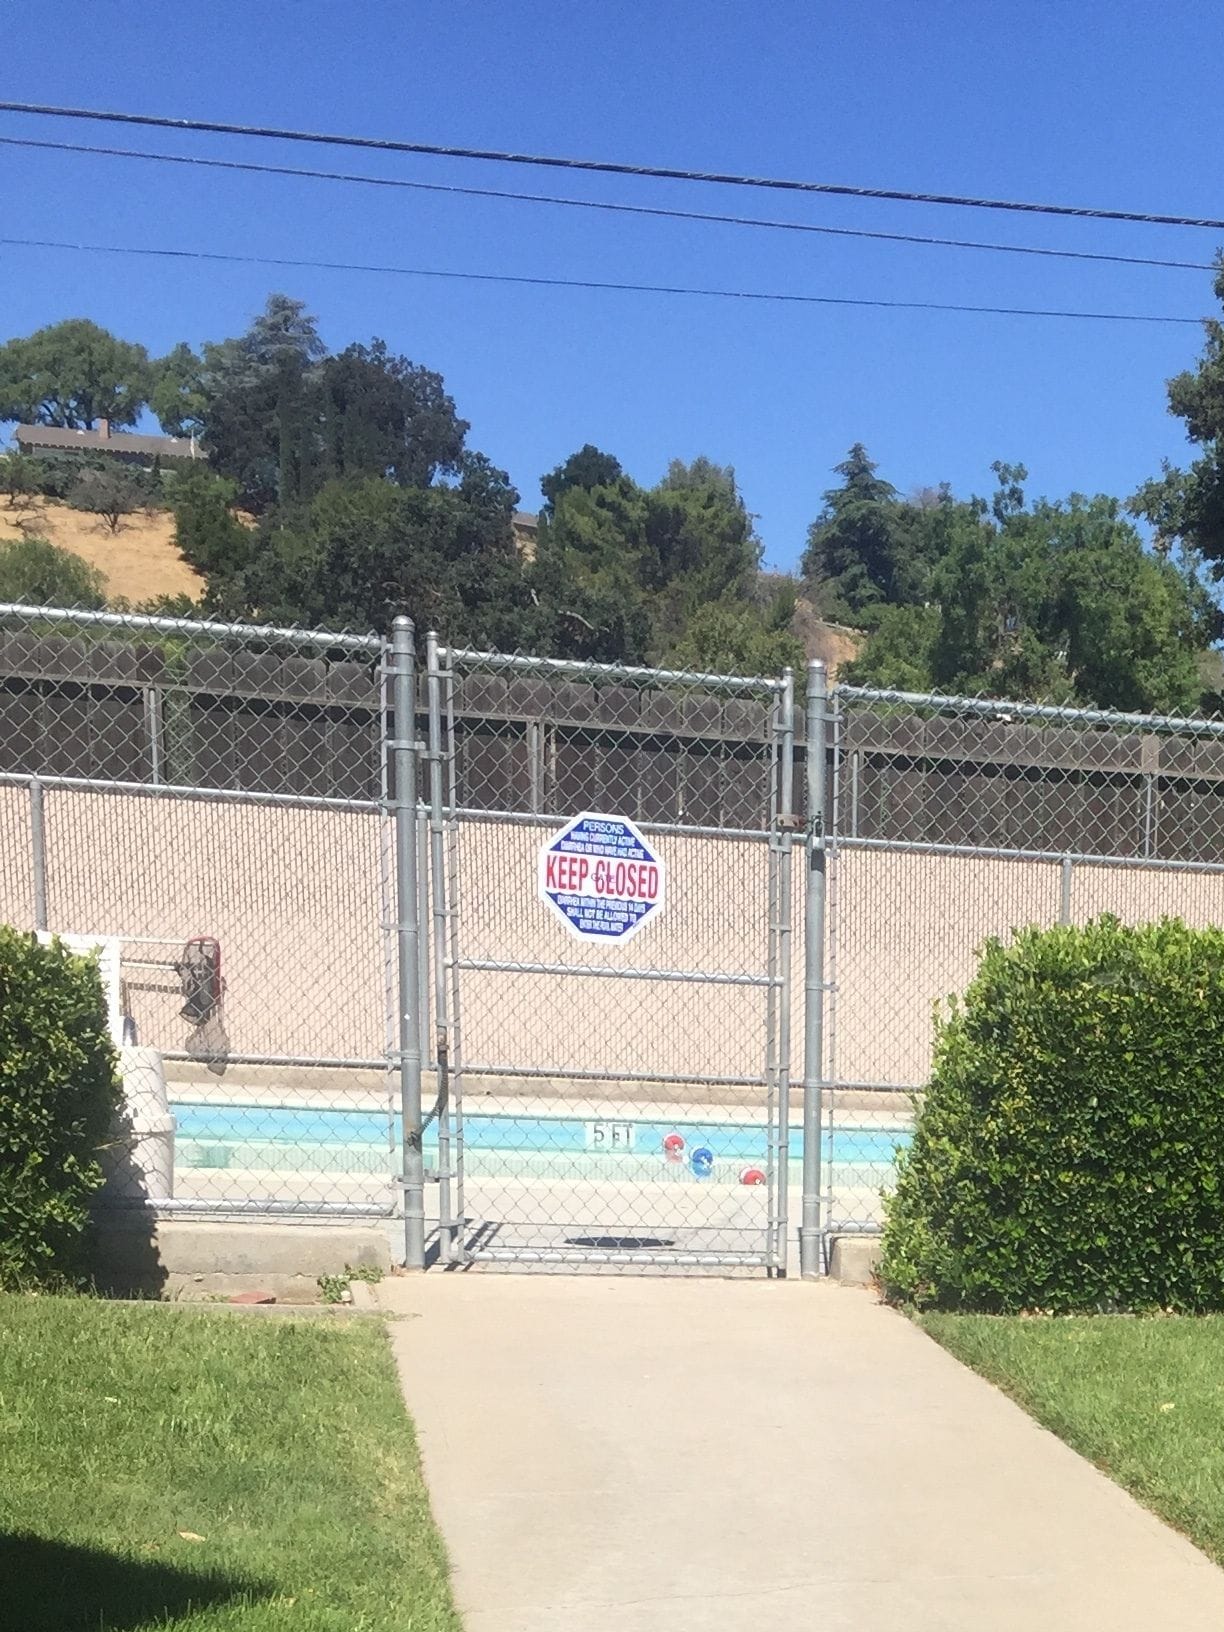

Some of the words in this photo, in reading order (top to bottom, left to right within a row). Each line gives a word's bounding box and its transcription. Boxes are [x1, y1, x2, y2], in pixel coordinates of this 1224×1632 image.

[583, 821, 624, 835] PERSONS
[546, 855, 589, 891] KEEP
[595, 859, 659, 899] CLOSED
[566, 906, 583, 918] SHALL
[584, 908, 595, 919] NOT
[596, 909, 604, 920] BE
[604, 910, 629, 923] ALLOWED
[593, 1123, 605, 1143] 5
[611, 1124, 634, 1145] FT
